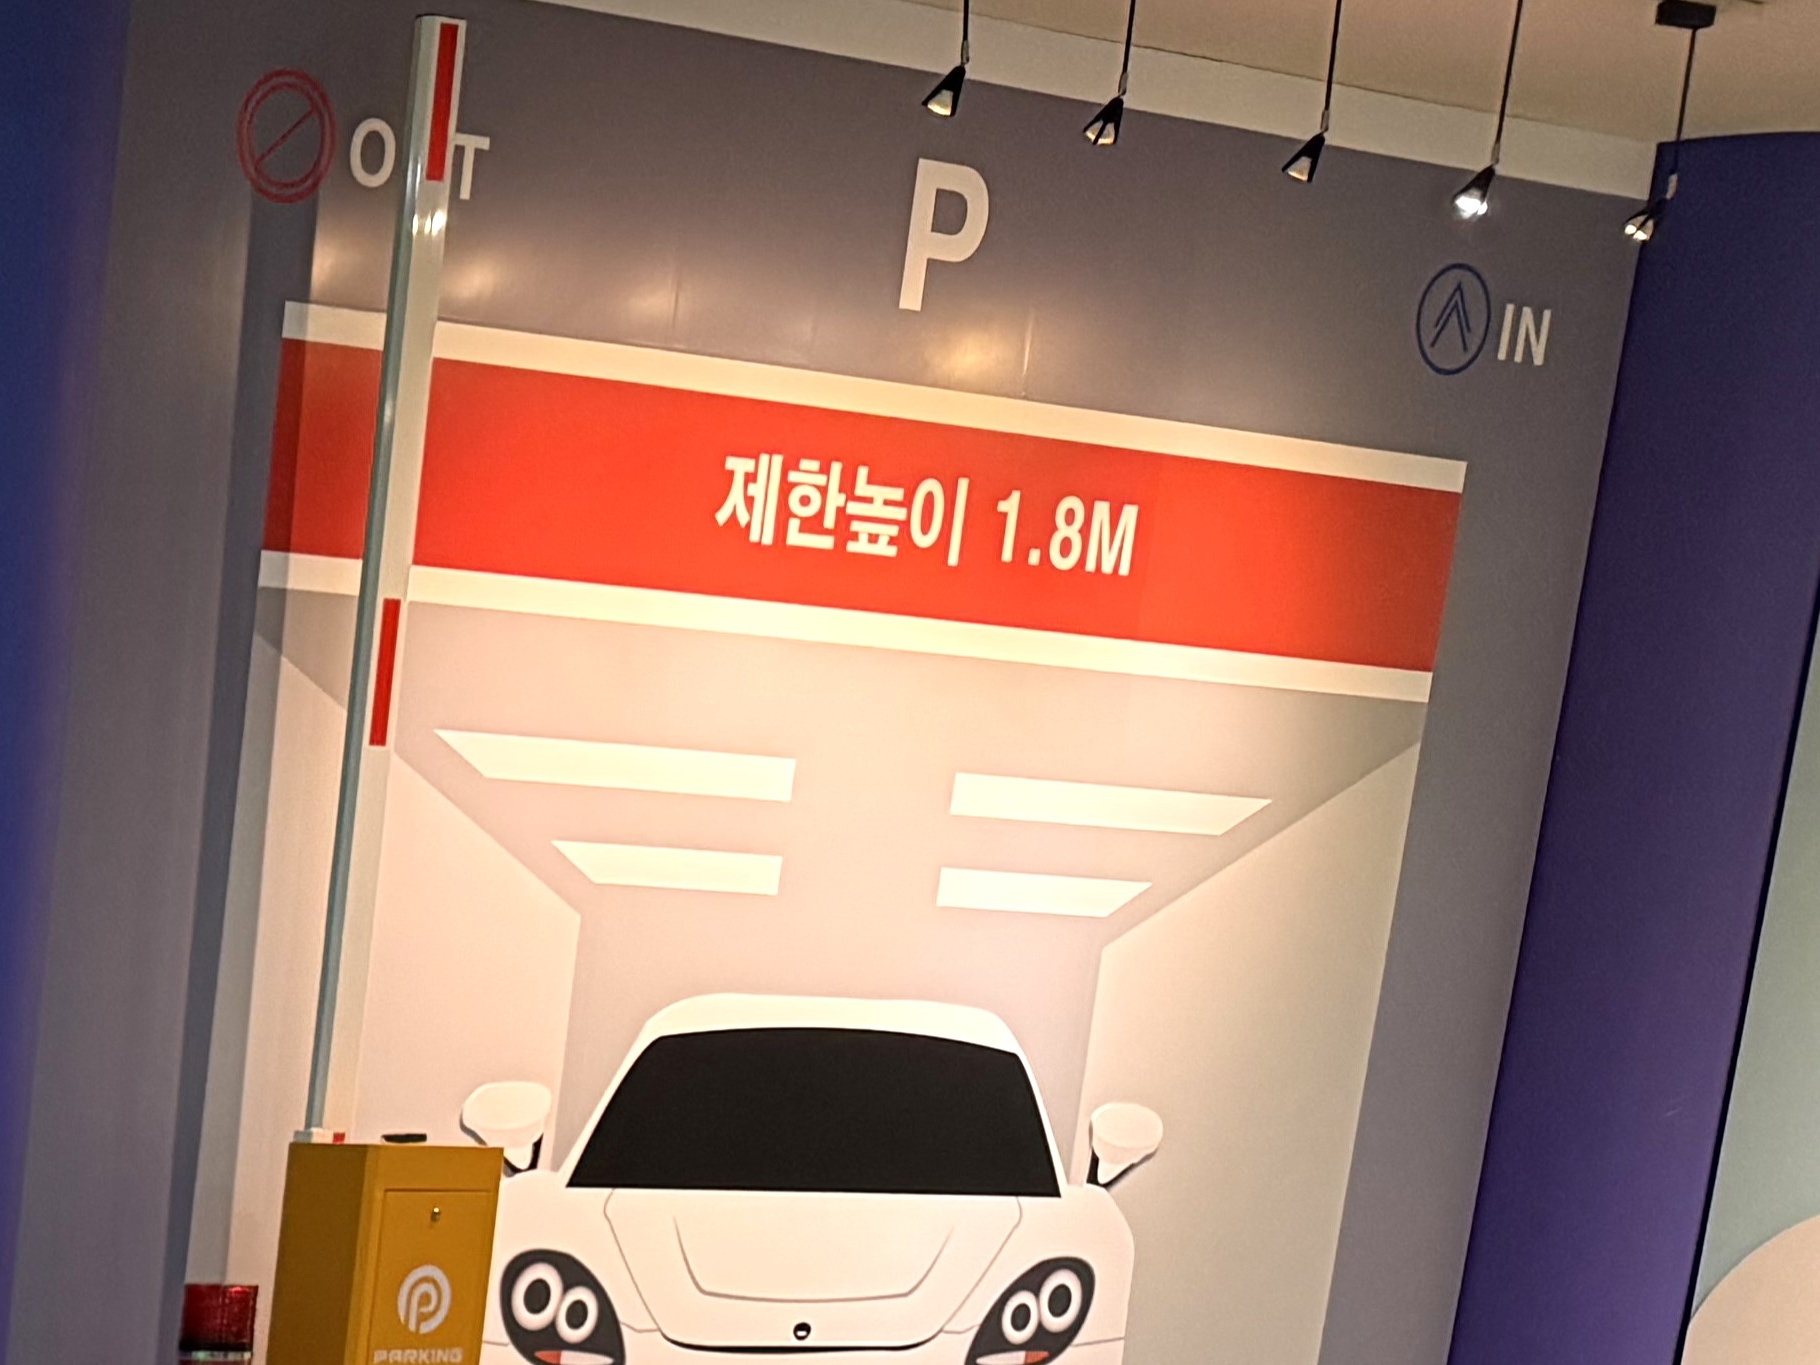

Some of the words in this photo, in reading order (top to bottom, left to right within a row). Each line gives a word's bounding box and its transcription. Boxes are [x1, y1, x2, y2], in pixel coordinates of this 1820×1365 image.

[350, 117, 491, 200] OT
[897, 156, 990, 312] P
[1495, 300, 1553, 368] IN
[713, 451, 969, 567] 제한높이
[995, 492, 1140, 579] 1.8M
[373, 1347, 464, 1365] PARKING
